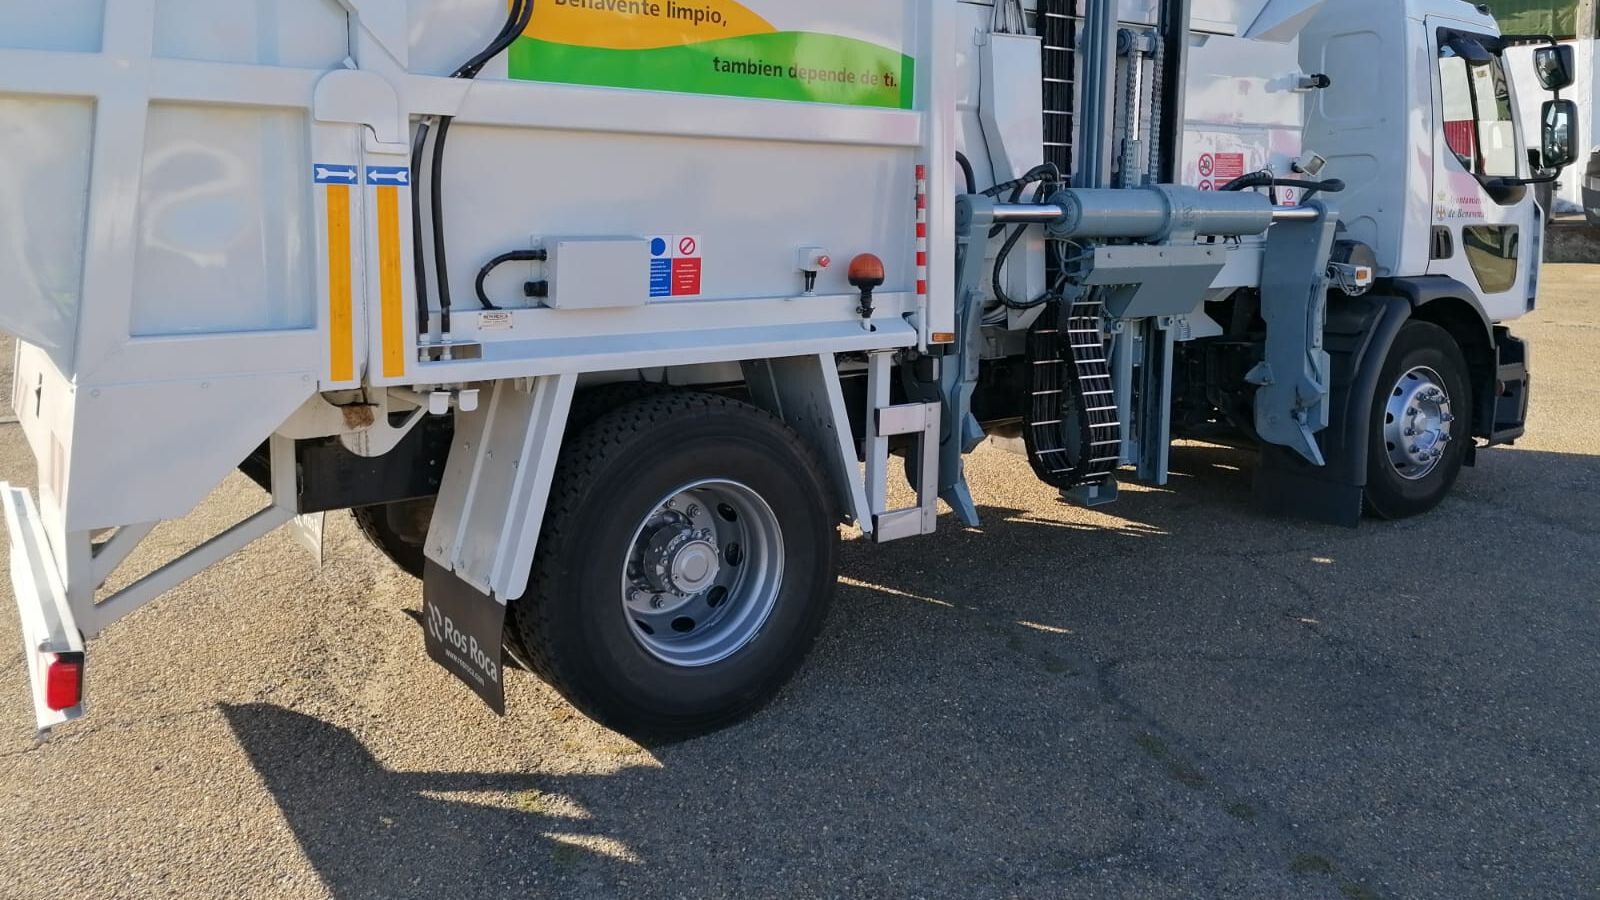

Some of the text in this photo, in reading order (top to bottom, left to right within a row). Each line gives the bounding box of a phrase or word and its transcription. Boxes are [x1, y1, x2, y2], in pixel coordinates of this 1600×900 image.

[666, 1, 727, 27] limpio,
[713, 56, 897, 87] tambien depende de ti.
[444, 616, 498, 684] Ros Roca
